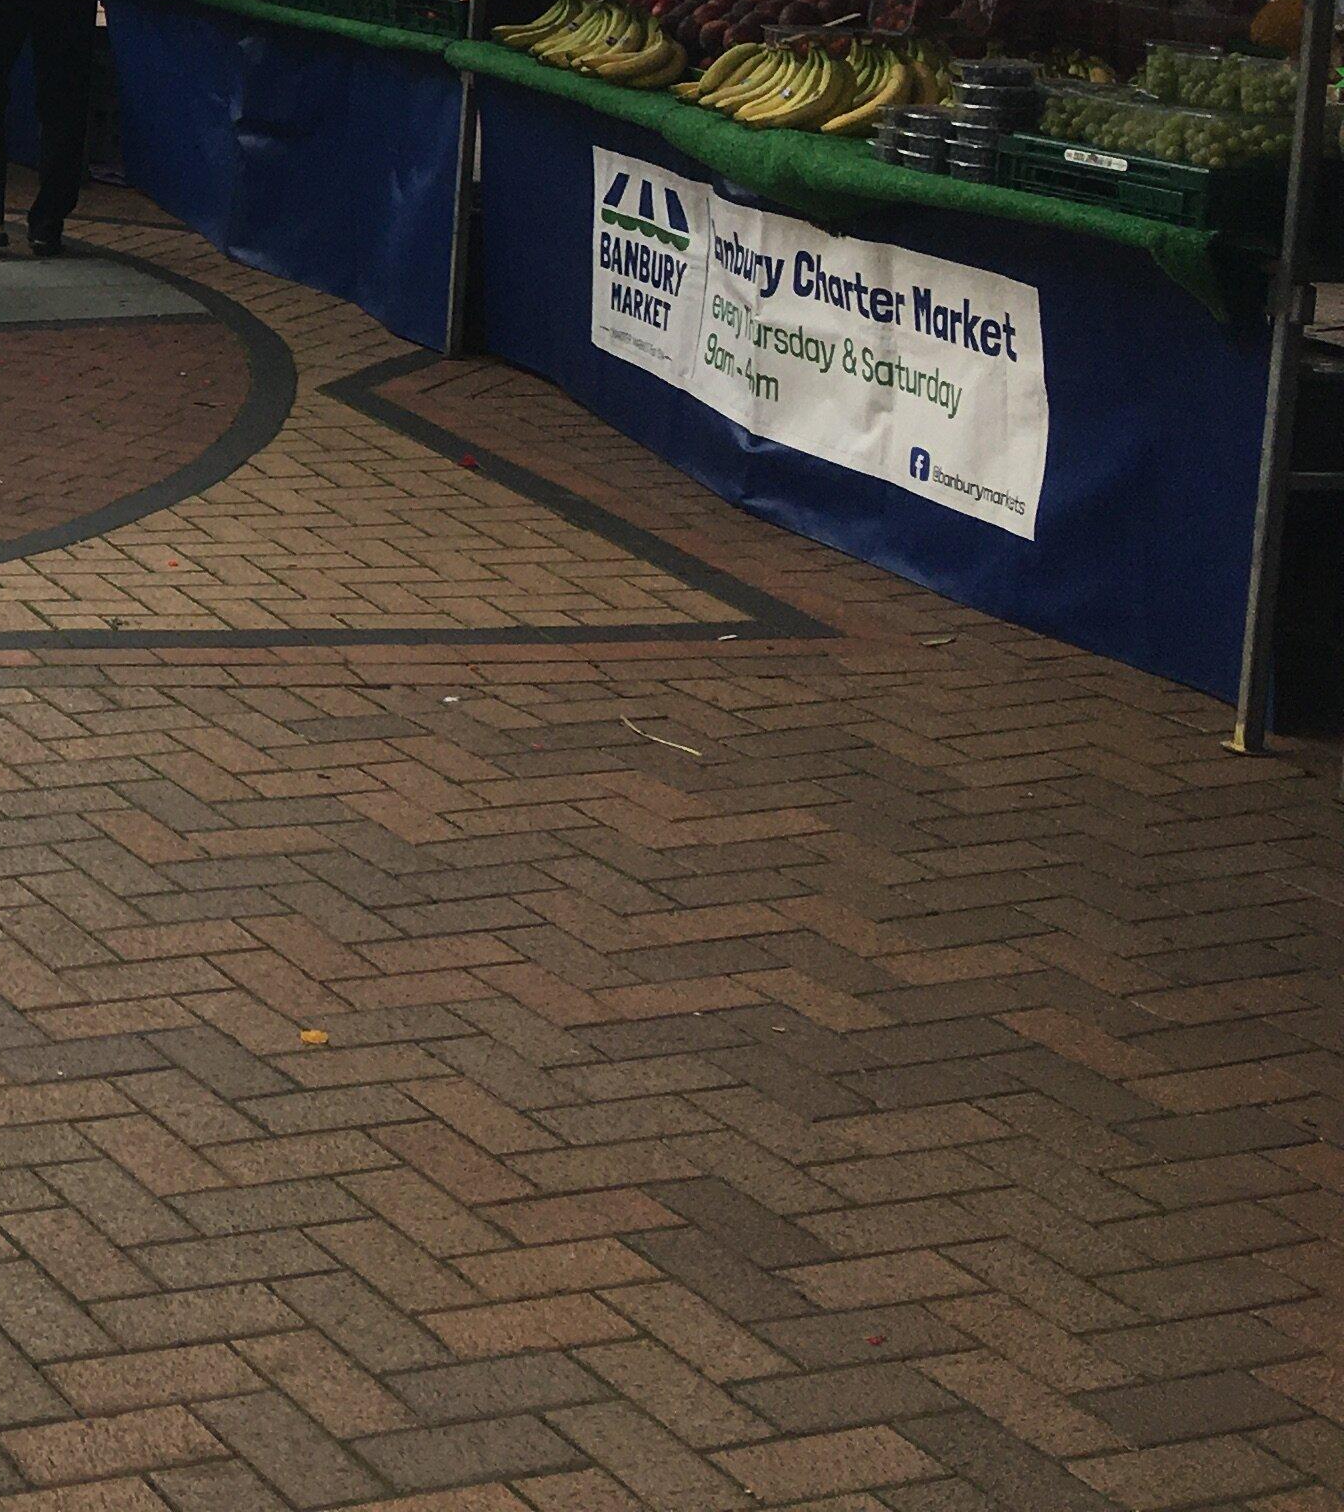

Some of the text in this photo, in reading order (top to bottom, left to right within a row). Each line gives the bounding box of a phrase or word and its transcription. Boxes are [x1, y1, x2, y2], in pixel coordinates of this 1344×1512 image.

[600, 231, 687, 297] BANBURY
[611, 282, 672, 331] MARKET
[712, 224, 1018, 363] anbury Charter Market
[712, 294, 742, 339] every
[842, 337, 858, 376] &
[862, 347, 963, 419] Saturday
